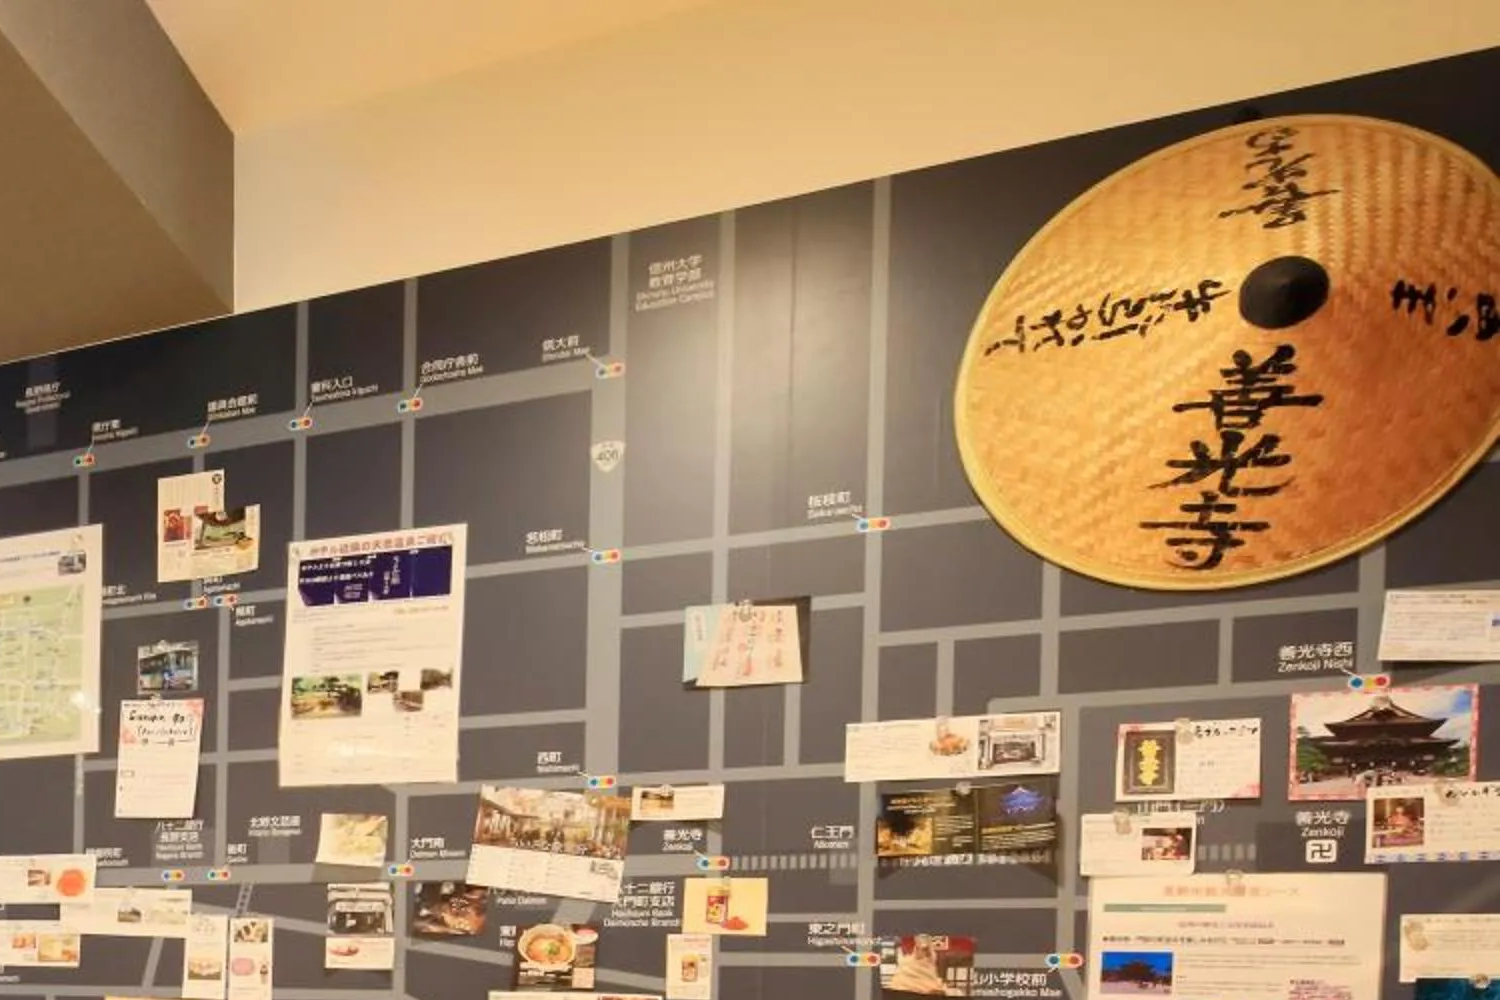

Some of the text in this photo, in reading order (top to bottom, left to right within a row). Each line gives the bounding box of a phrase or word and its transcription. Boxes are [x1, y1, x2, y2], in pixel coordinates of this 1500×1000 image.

[1140, 345, 1323, 568] 善光寺
[1278, 641, 1354, 661] 善光寺西
[1277, 660, 1321, 673] Zenkoji
[1295, 811, 1351, 826] 善光寺
[811, 825, 855, 840] 仁王門
[1300, 826, 1345, 840] Zenkoji
